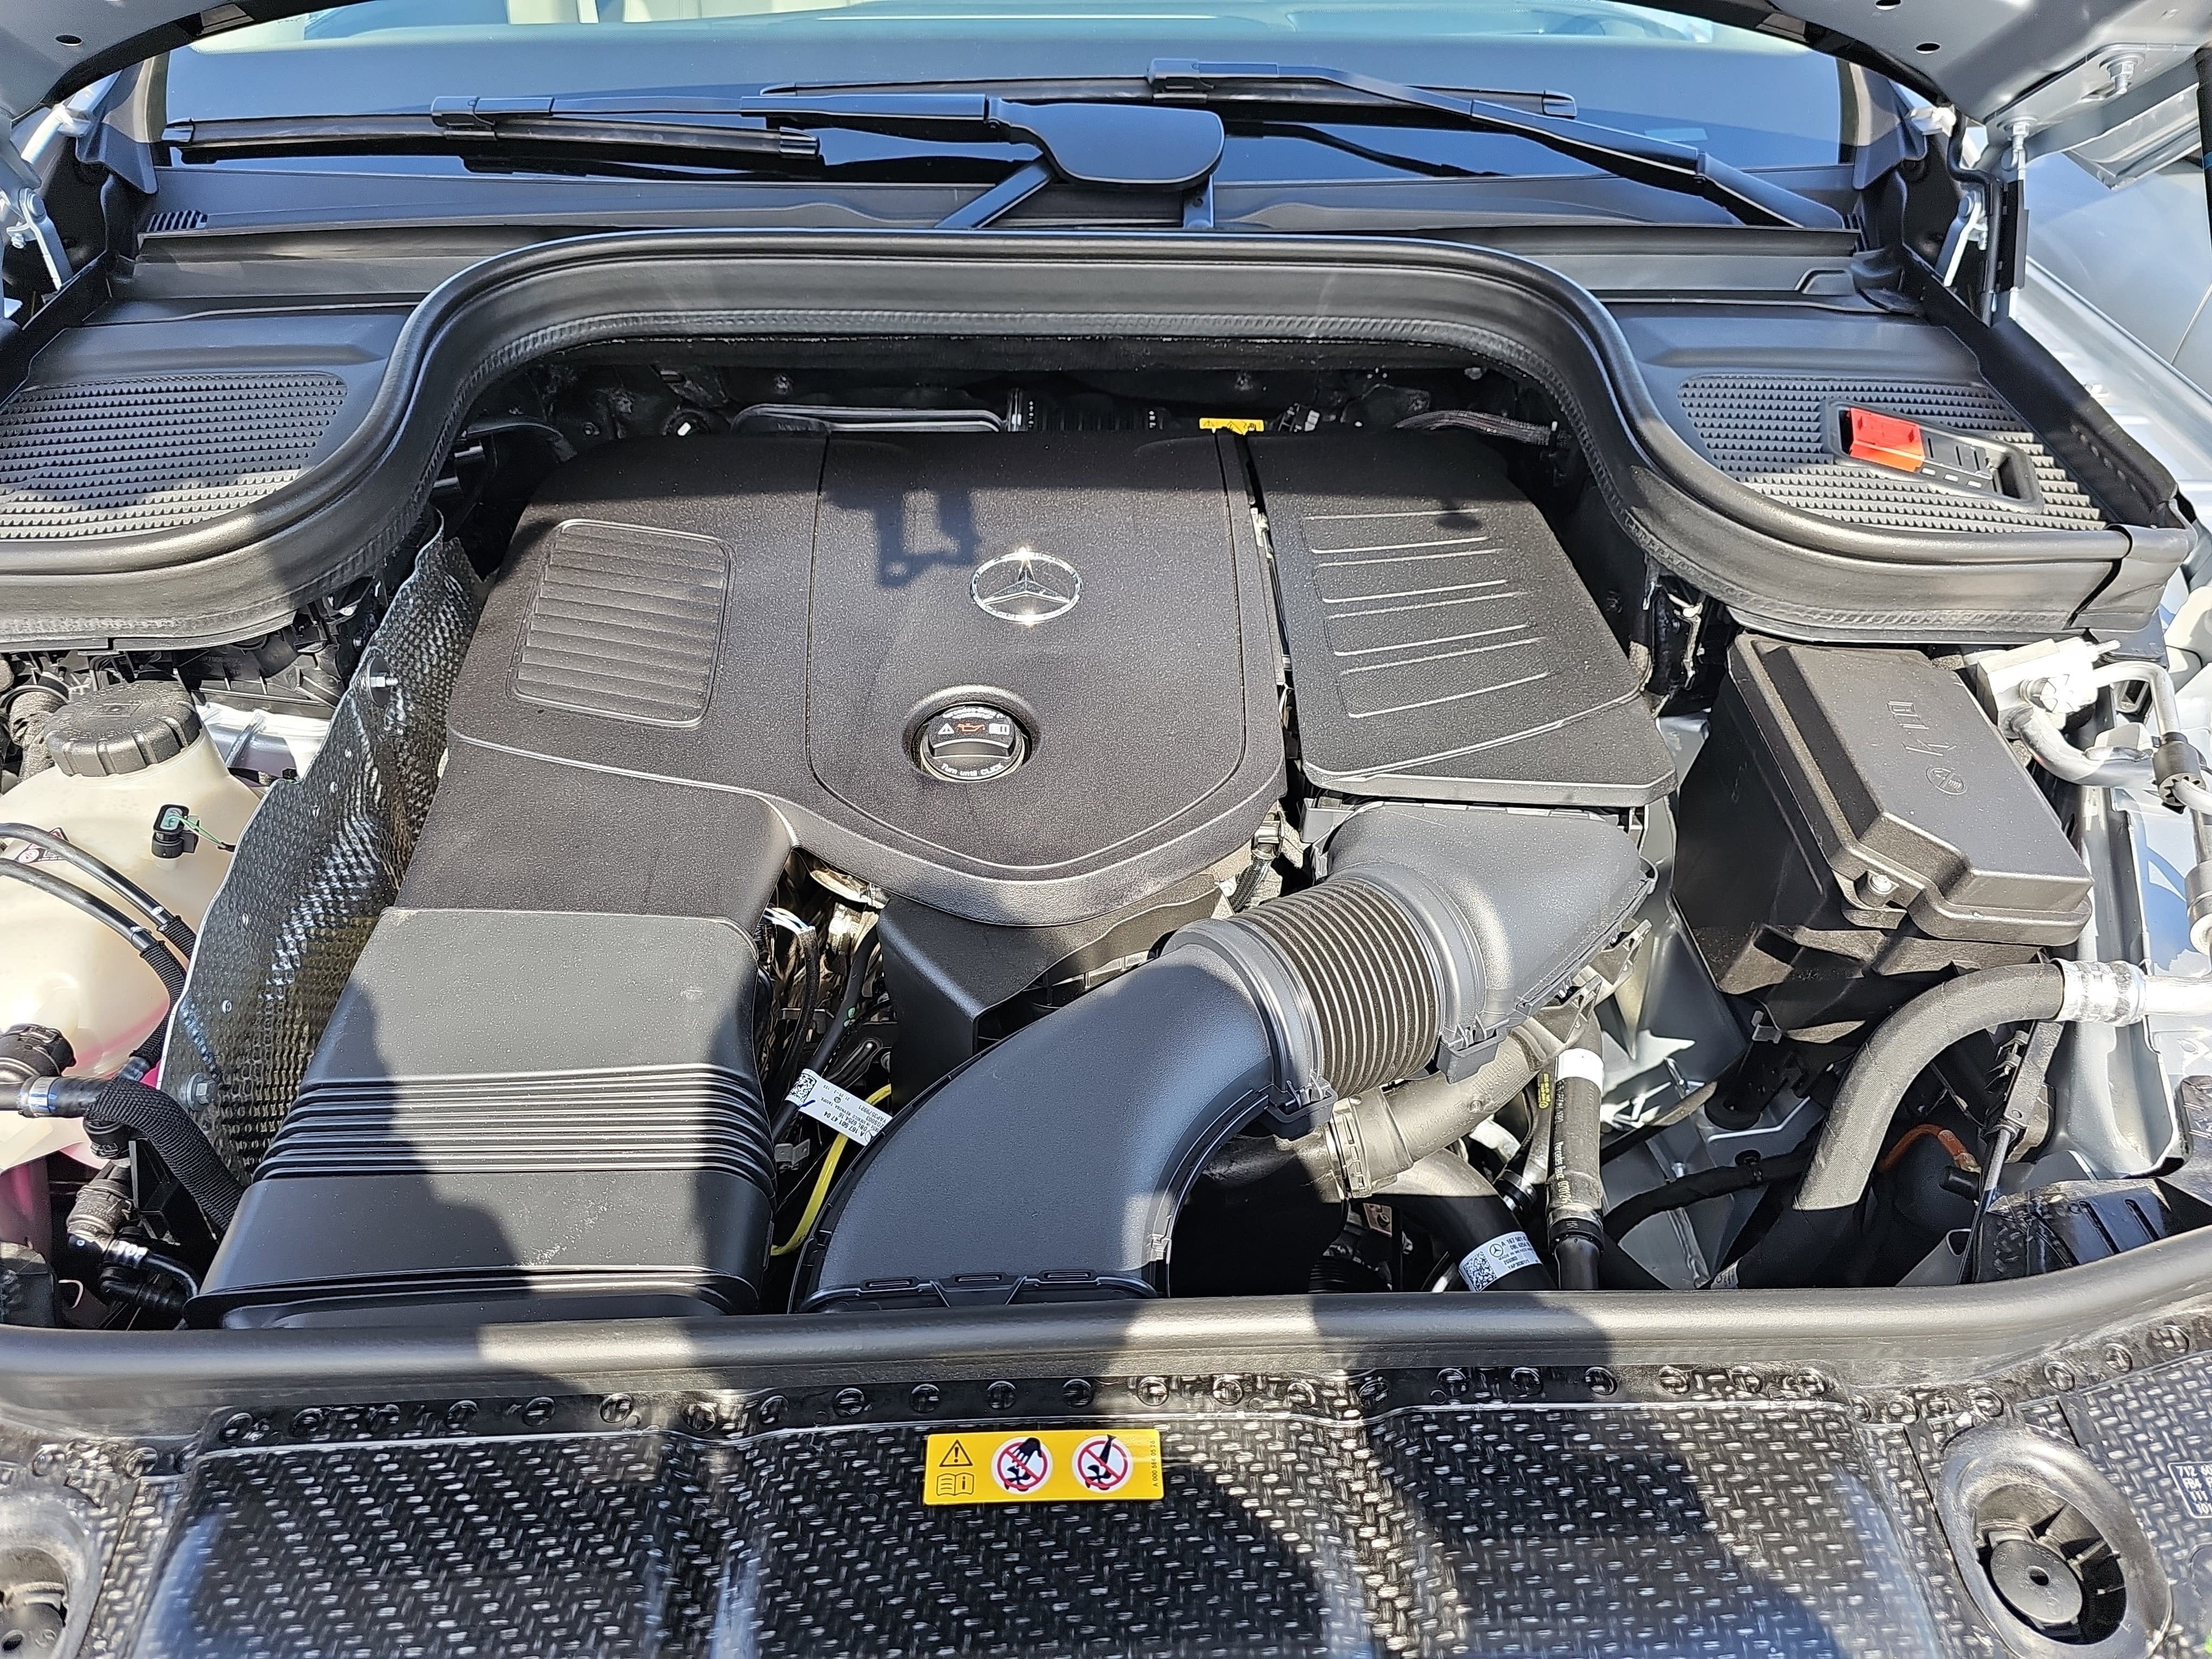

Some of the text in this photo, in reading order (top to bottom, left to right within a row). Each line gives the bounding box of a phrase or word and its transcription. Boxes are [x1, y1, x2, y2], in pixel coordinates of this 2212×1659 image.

[941, 763, 958, 775] Turn
[980, 762, 1005, 775] CLICK
[848, 1126, 859, 1134] 167
